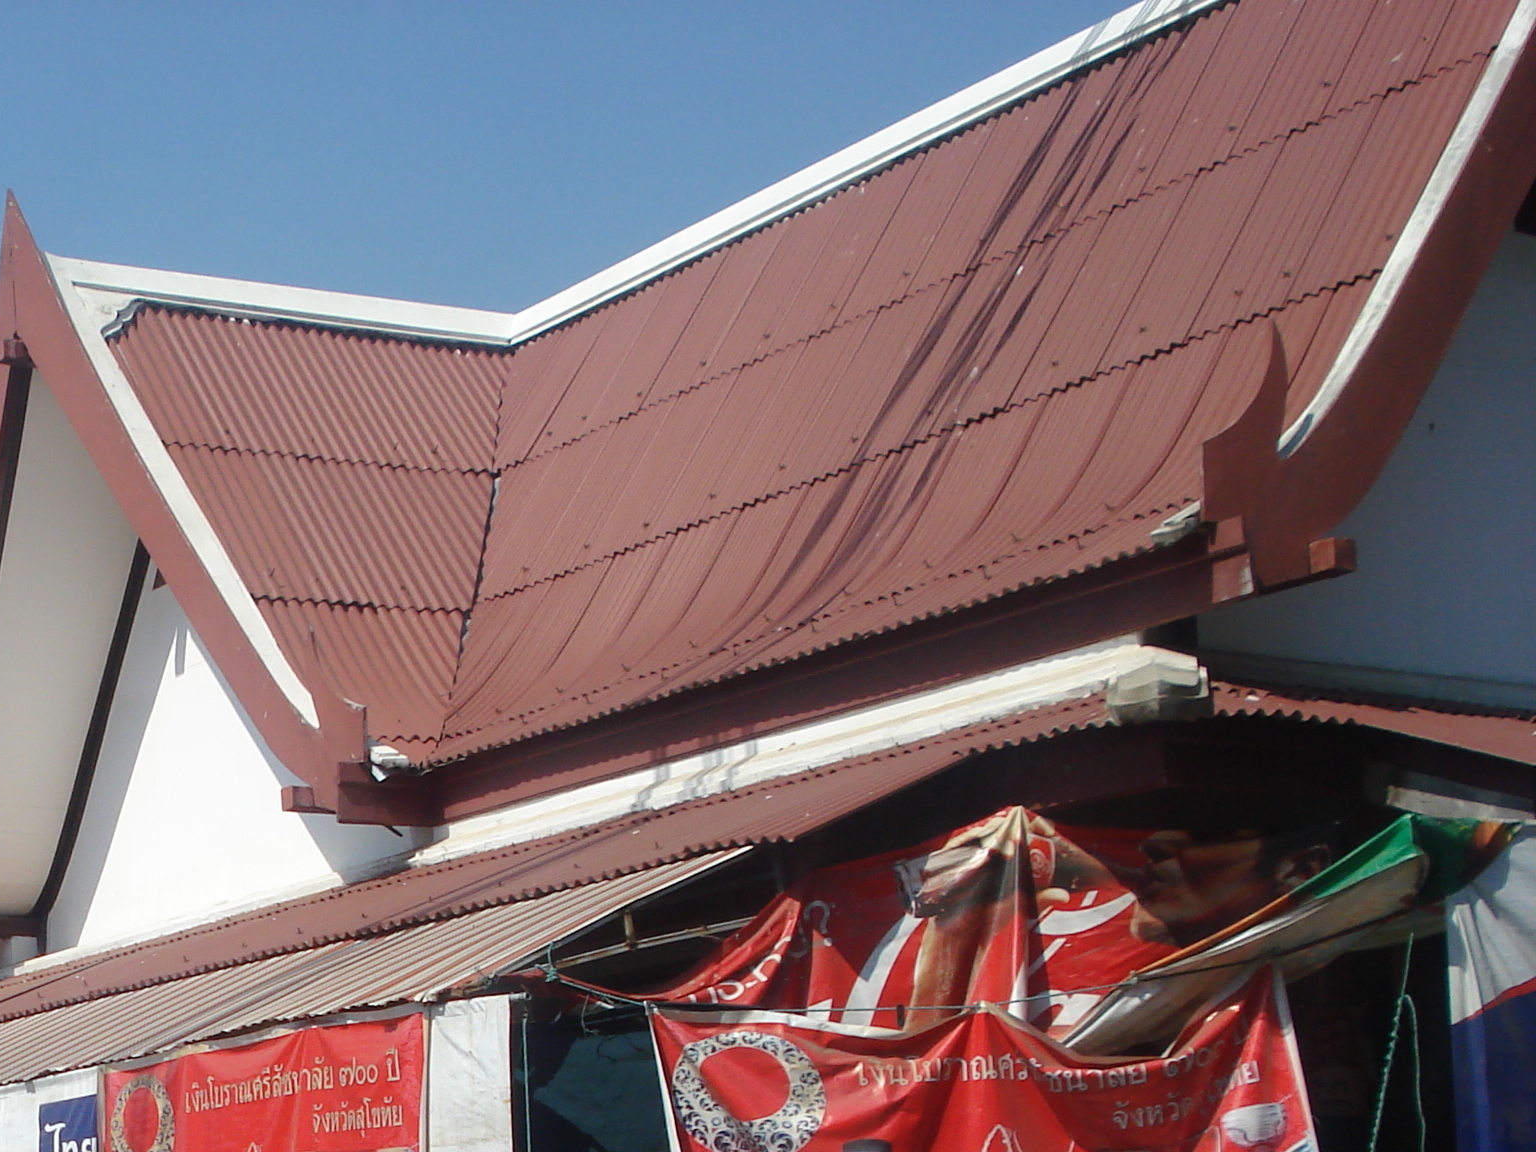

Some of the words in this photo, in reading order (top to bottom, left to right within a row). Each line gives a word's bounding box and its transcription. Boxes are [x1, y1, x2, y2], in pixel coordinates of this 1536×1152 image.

[340, 1057, 379, 1087] ๗๐๐
[386, 1048, 401, 1082] ปี
[312, 1096, 403, 1138] จังหวัดสุโขทัย
